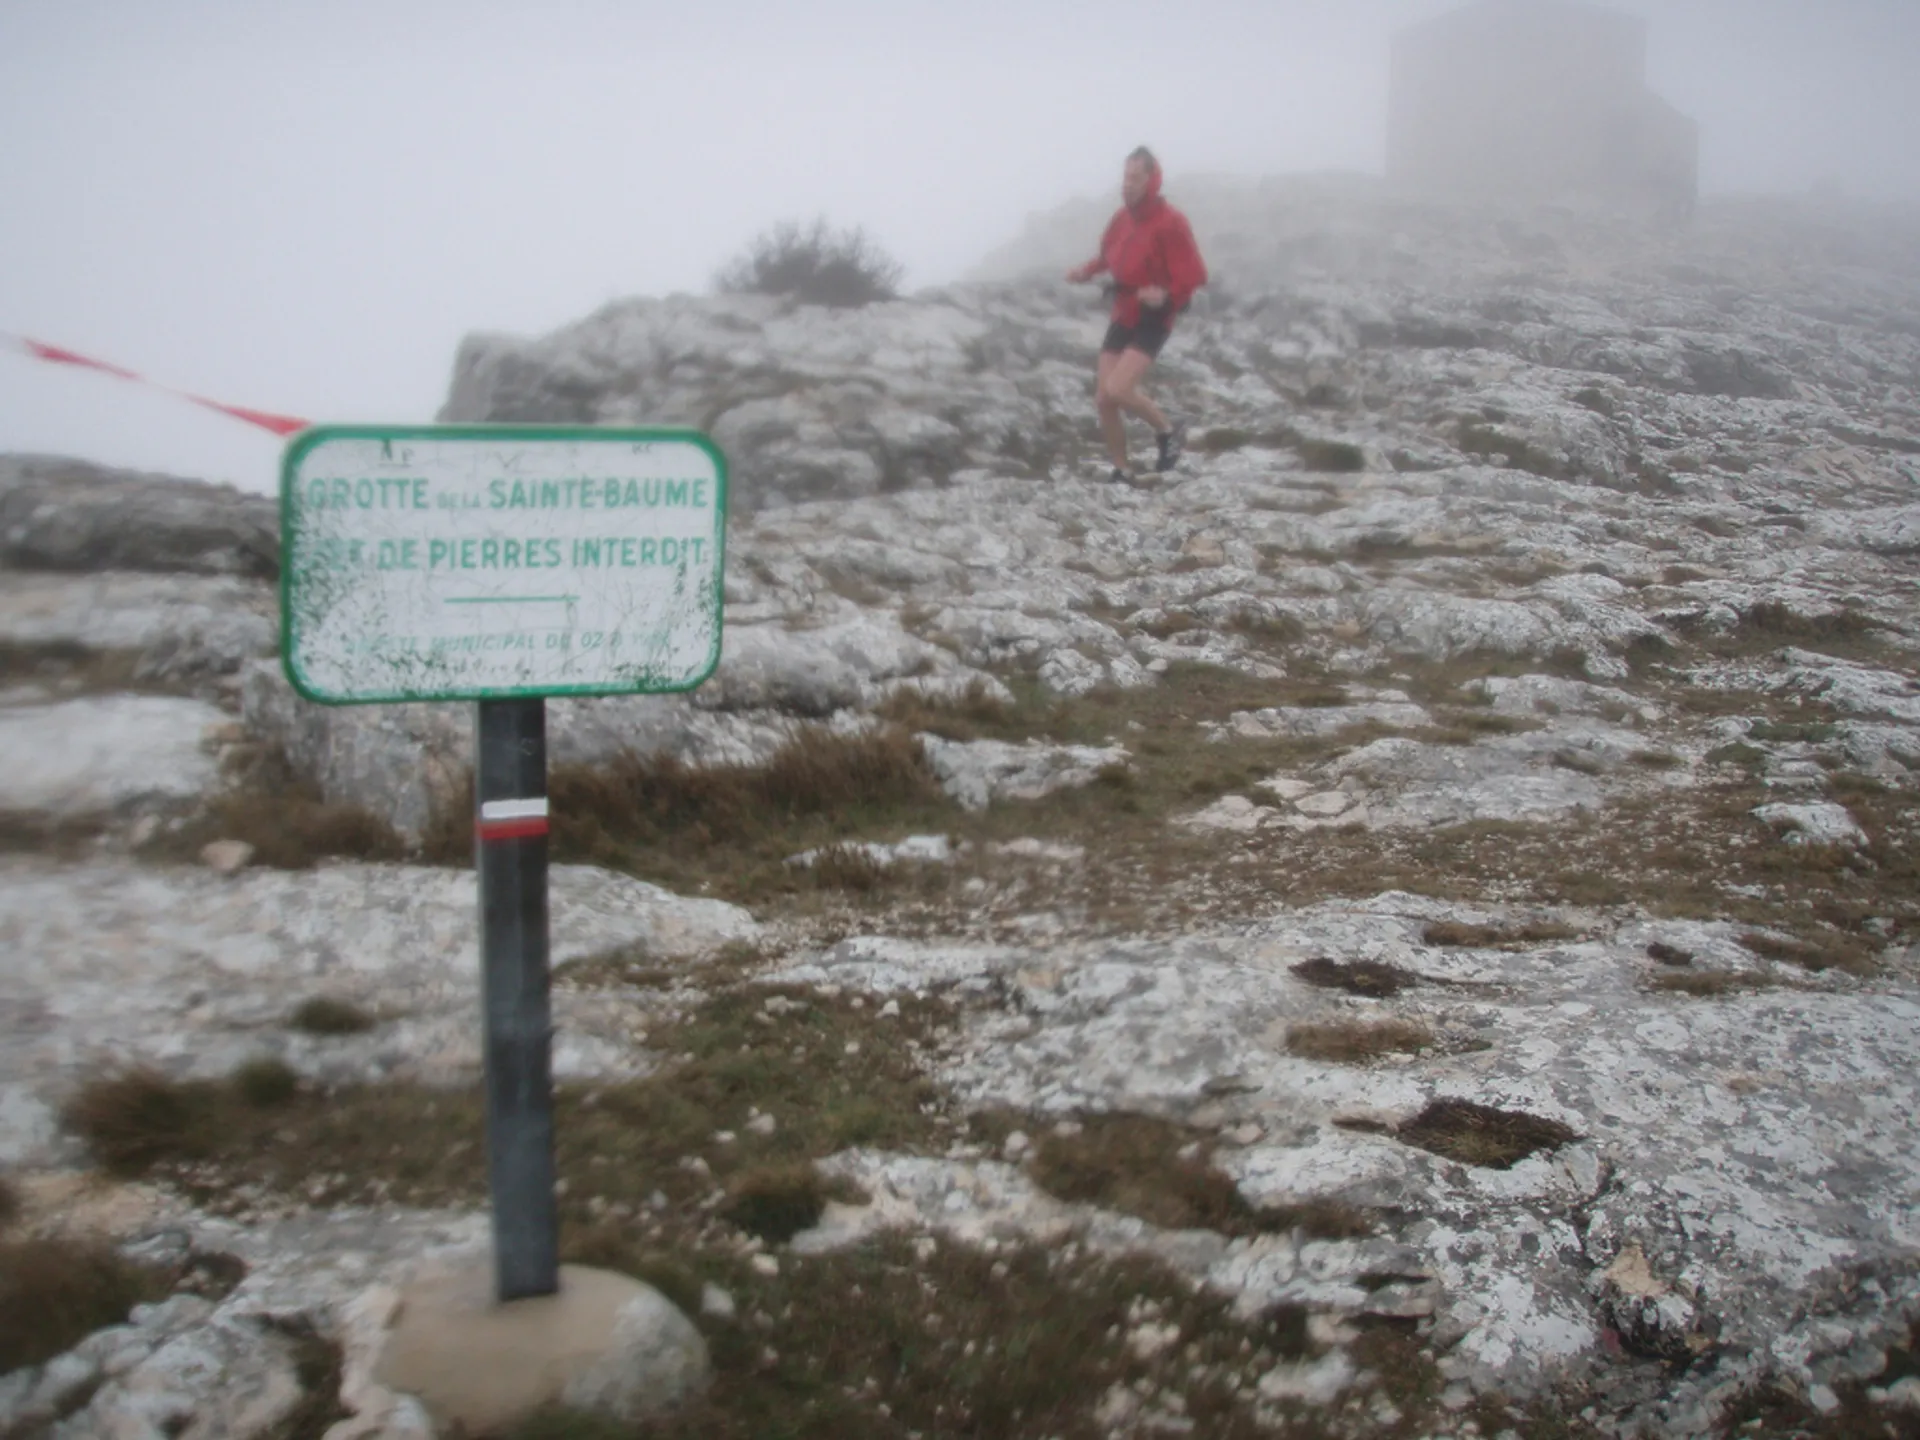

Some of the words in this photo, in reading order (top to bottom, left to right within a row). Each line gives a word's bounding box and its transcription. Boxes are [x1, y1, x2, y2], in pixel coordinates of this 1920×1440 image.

[307, 477, 430, 509] GROTTE
[489, 476, 709, 509] SAINTE-BAUME
[378, 538, 419, 570] DE
[429, 537, 561, 569] PIERRES
[572, 536, 706, 567] INTERDIT
